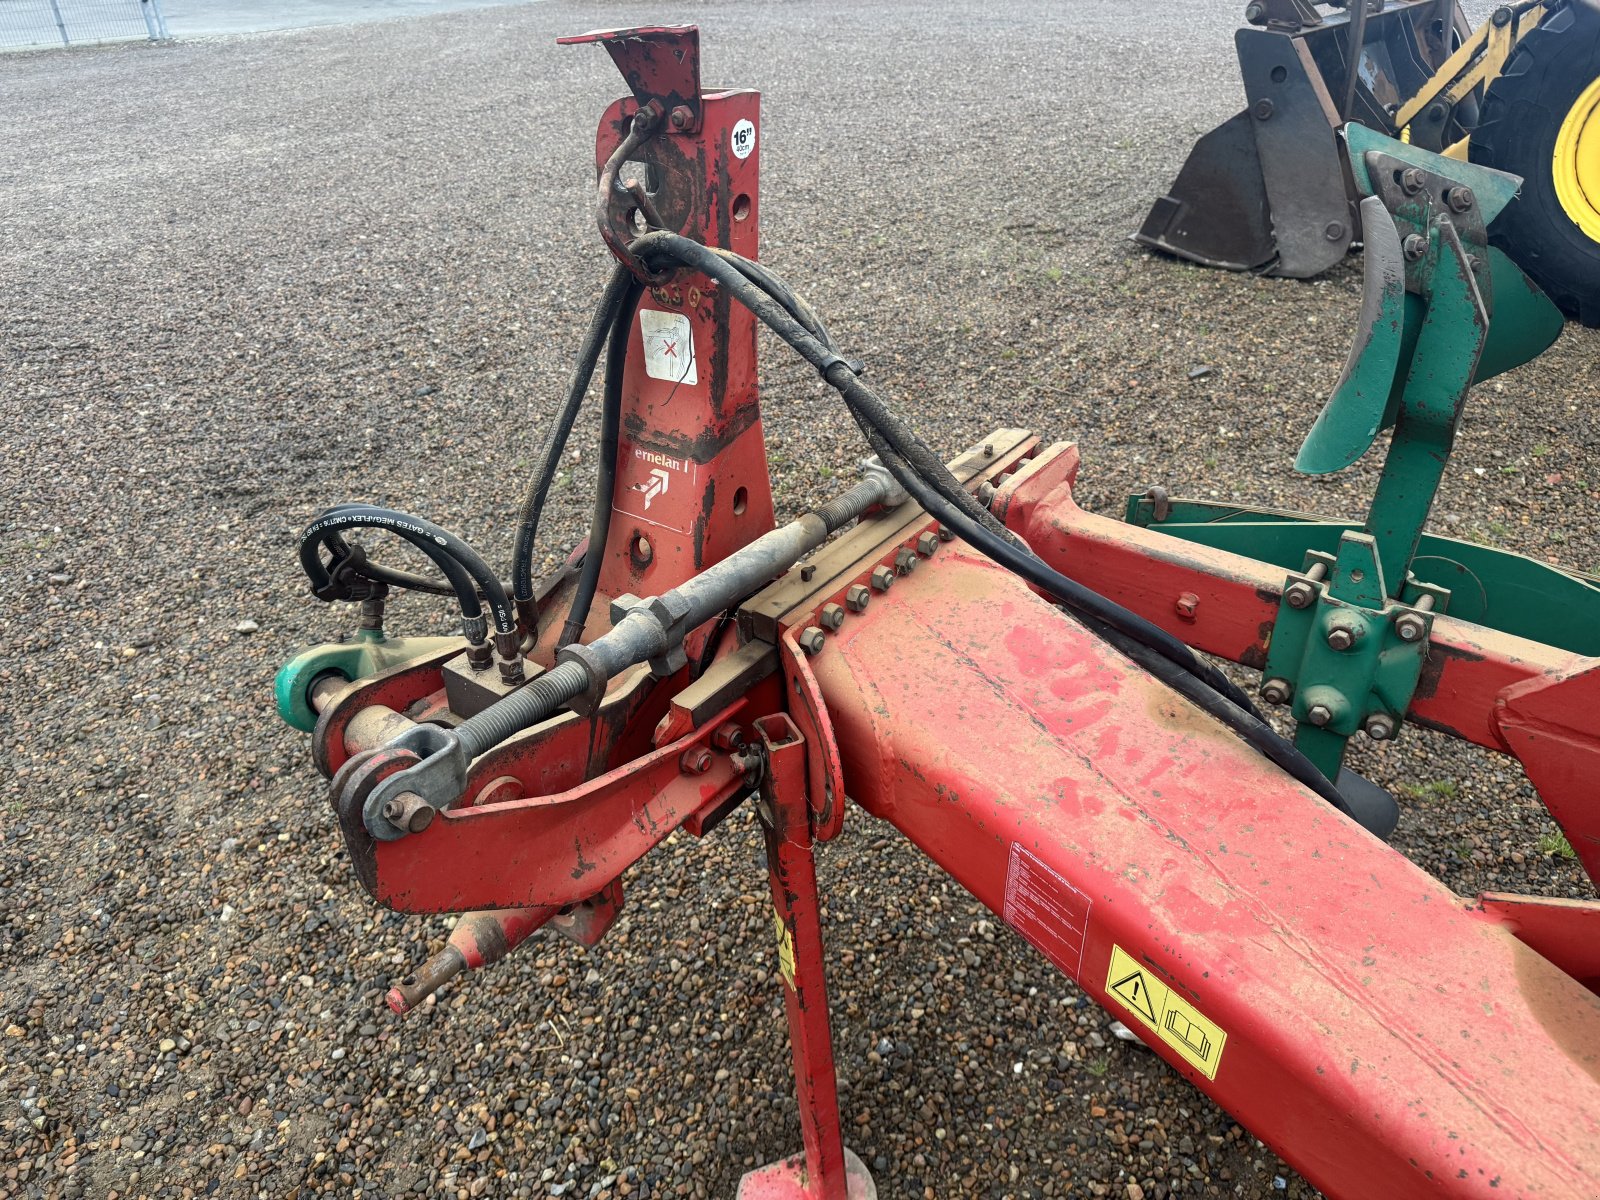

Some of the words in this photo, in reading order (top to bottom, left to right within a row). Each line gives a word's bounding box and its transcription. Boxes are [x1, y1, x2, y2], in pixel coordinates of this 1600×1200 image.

[734, 127, 752, 146] 16"
[351, 515, 395, 526] MEGAFLEX
[396, 520, 424, 535] GATES
